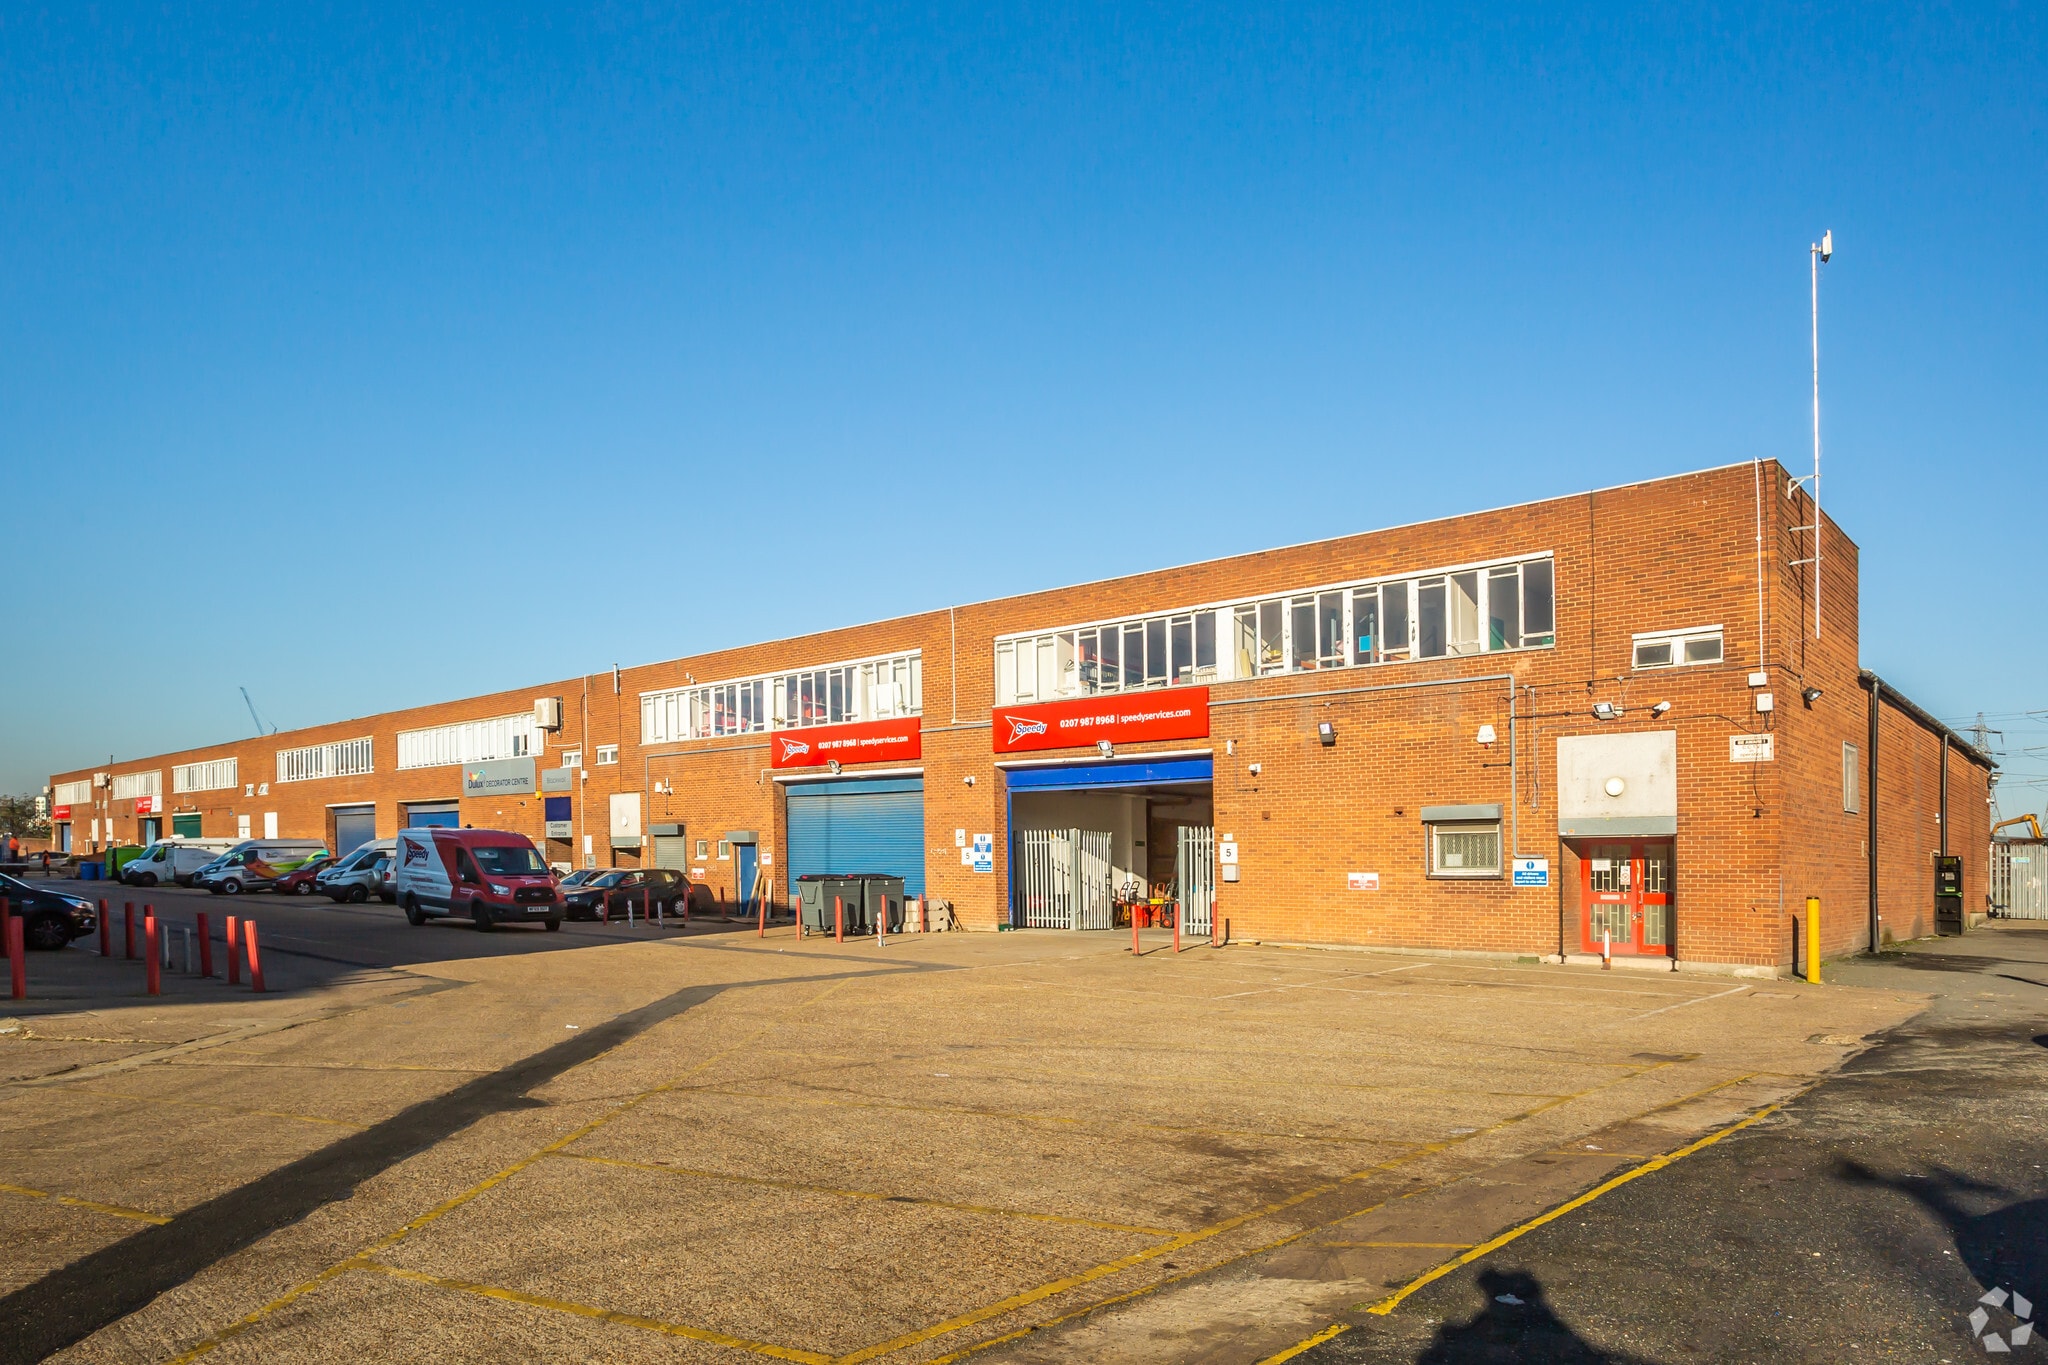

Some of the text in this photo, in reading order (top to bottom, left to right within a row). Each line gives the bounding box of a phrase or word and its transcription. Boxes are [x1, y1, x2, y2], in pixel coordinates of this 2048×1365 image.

[1060, 709, 1191, 728] 0207 987 8968 speedyservices.com
[1015, 722, 1048, 735] Speedy
[787, 743, 810, 754] Speedy
[818, 741, 831, 749] 0207
[832, 740, 842, 748] 987
[468, 777, 529, 789] Dulux DECORATOR CENTRE
[408, 844, 429, 861] Speedy
[965, 852, 970, 860] 5
[1225, 848, 1232, 857] 5
